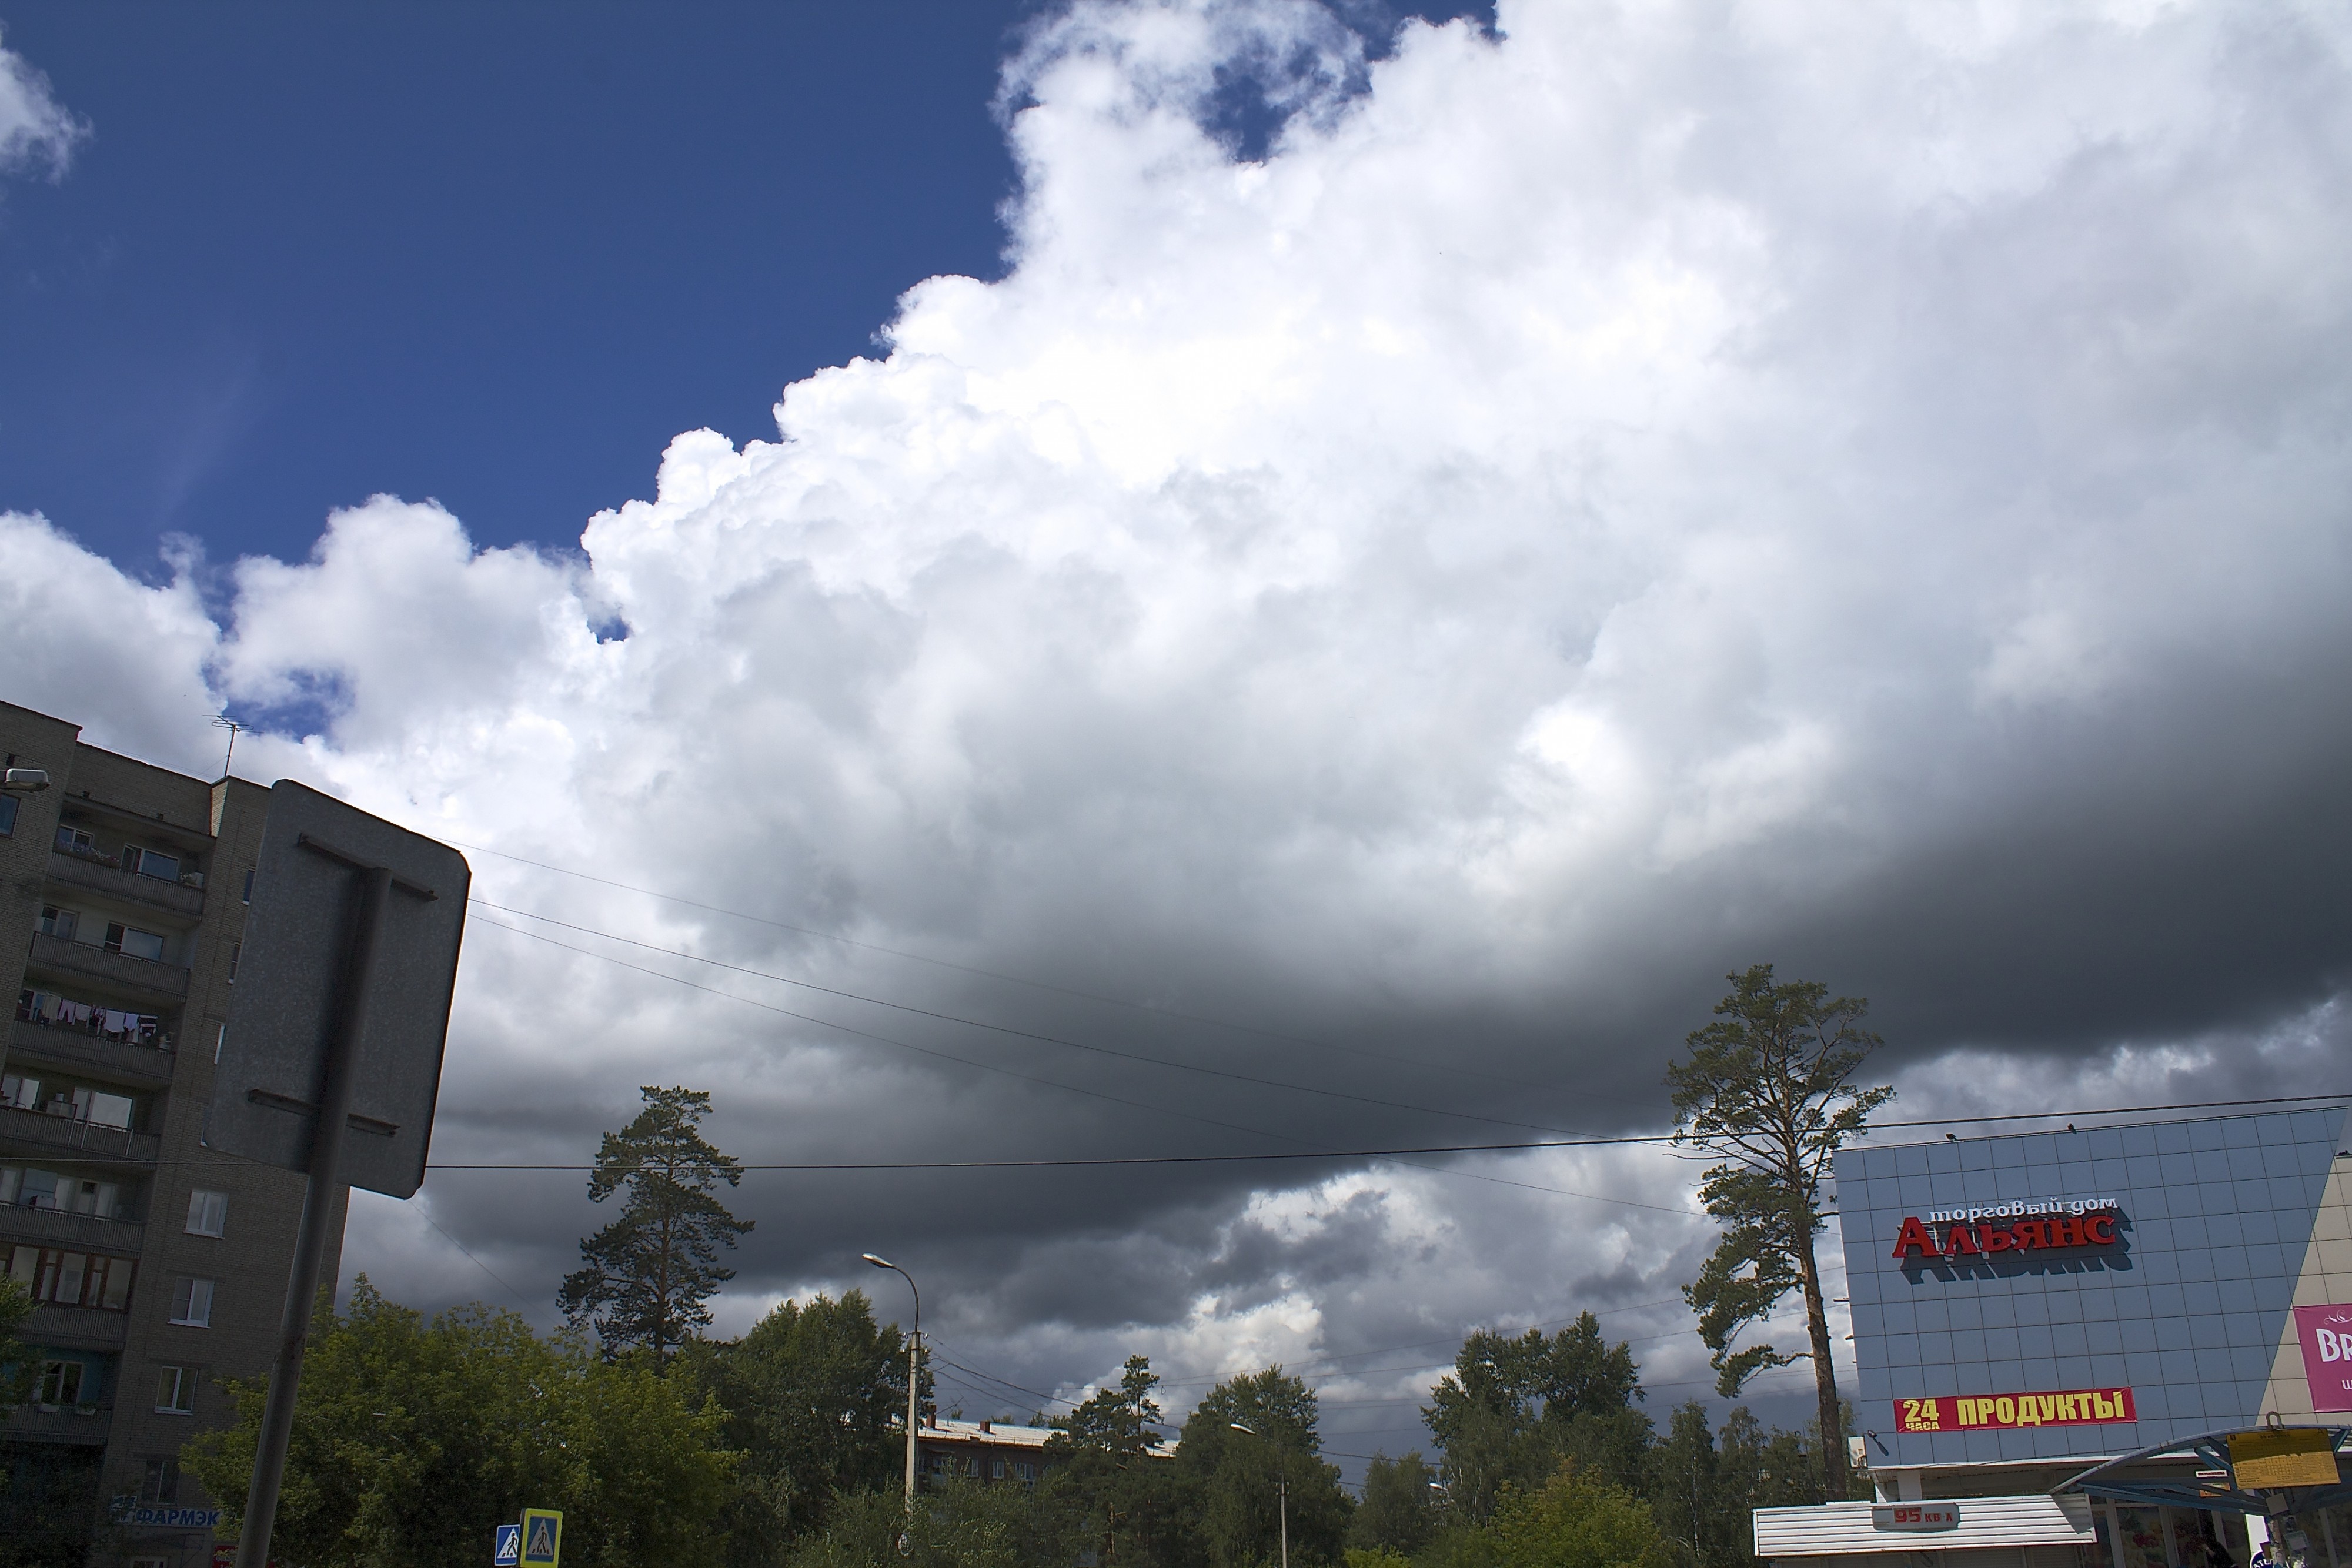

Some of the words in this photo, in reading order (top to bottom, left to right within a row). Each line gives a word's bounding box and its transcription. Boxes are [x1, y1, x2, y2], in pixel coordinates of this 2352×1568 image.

[1929, 1197, 2062, 1223] торговый
[2071, 1198, 2117, 1215] дом
[1903, 1399, 1939, 1422] 24
[1957, 1392, 2124, 1426] ПРОДУКТЫ
[1905, 1421, 1940, 1431] ЧАСА
[1895, 1509, 1921, 1523] 95
